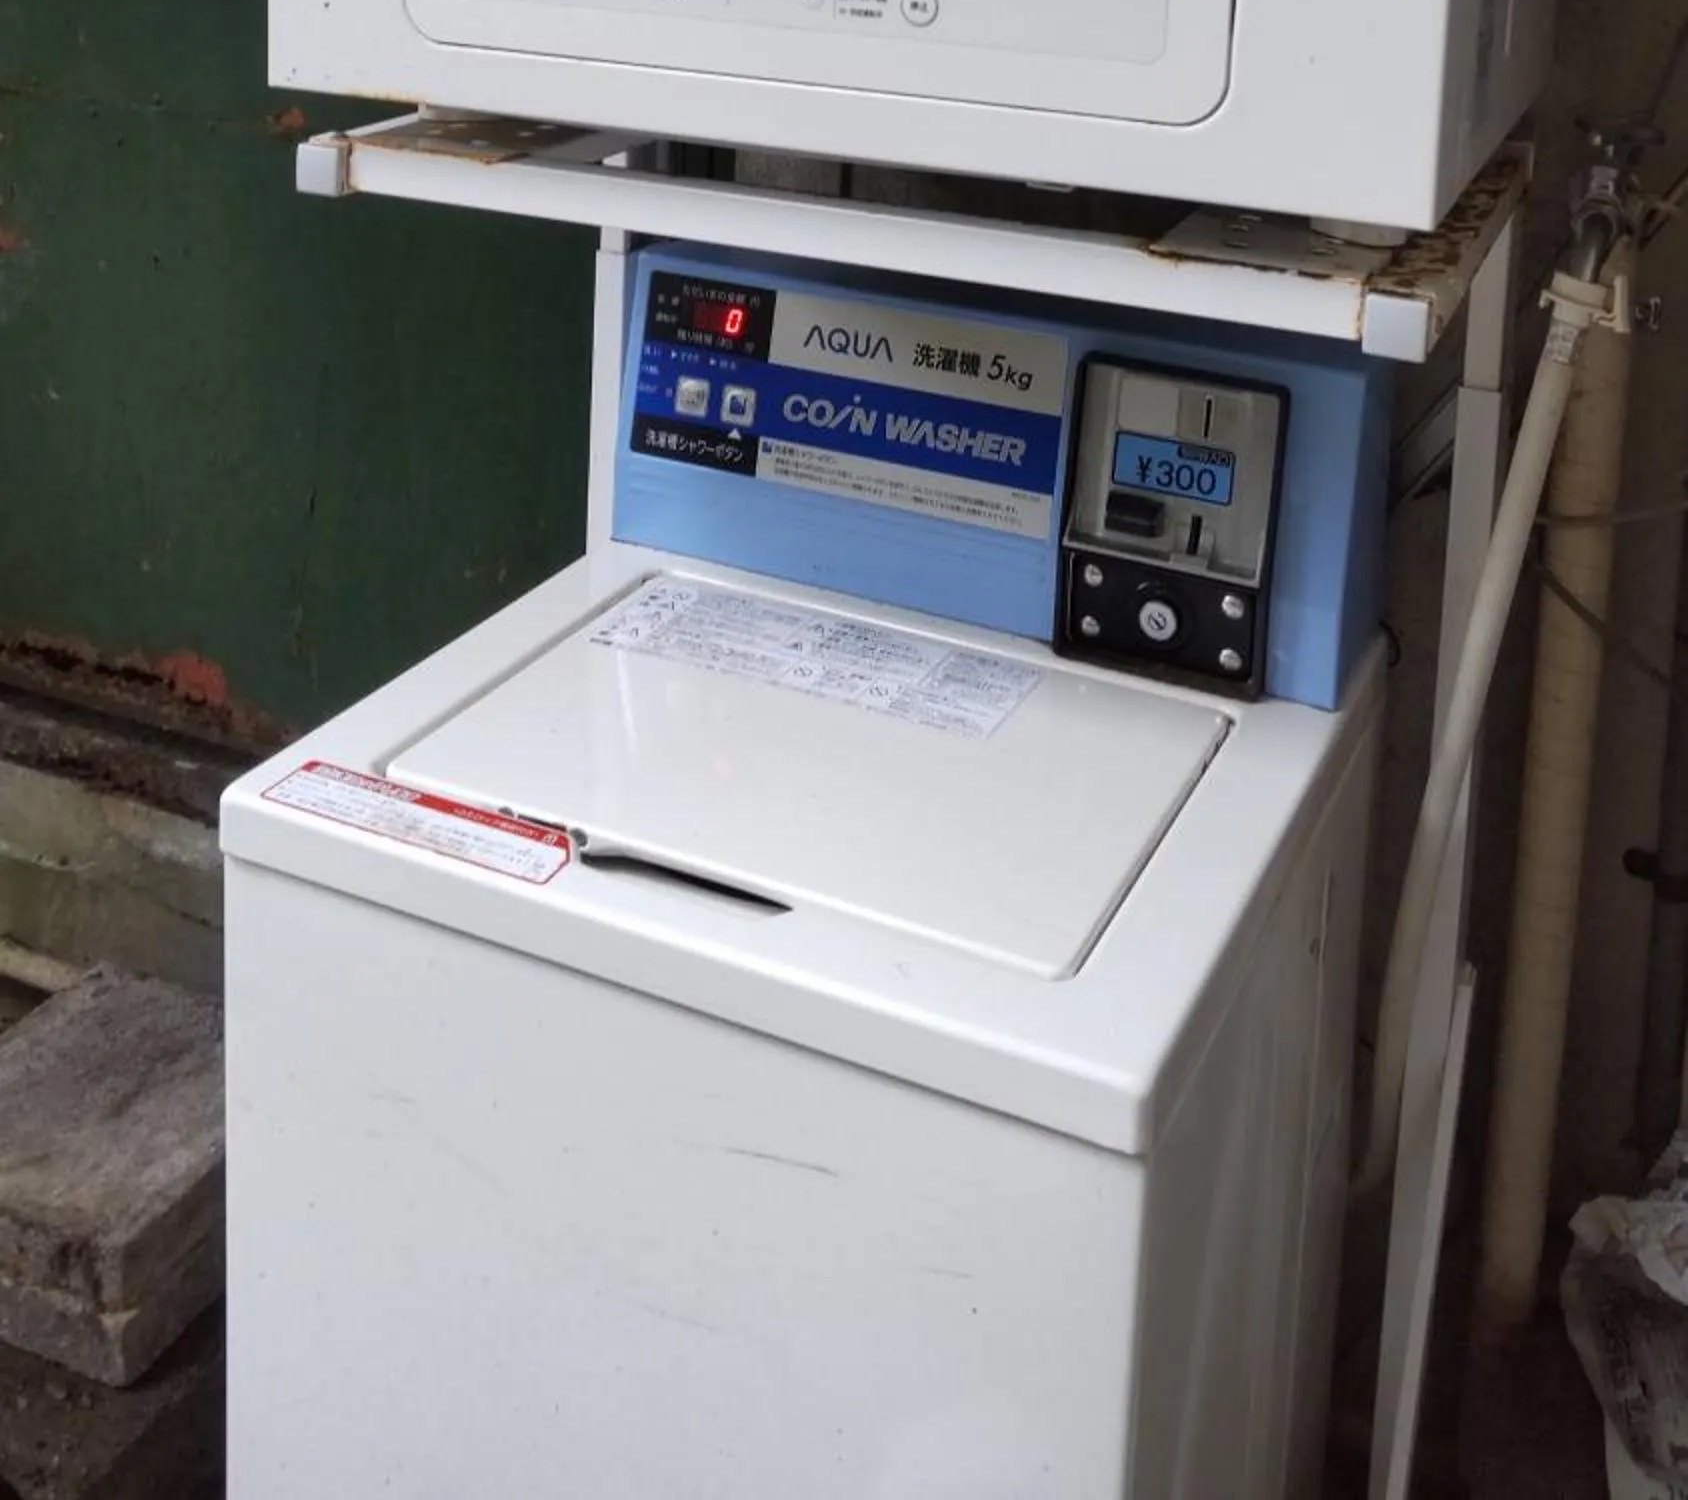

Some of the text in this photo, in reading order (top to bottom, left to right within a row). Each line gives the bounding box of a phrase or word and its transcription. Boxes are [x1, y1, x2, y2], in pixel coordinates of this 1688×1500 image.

[725, 309, 743, 334] 0
[804, 324, 893, 363] AQUA
[913, 343, 1034, 391] 洗濯機 5kg
[783, 394, 1027, 467] COIN WASHER
[1136, 454, 1217, 496] ¥300
